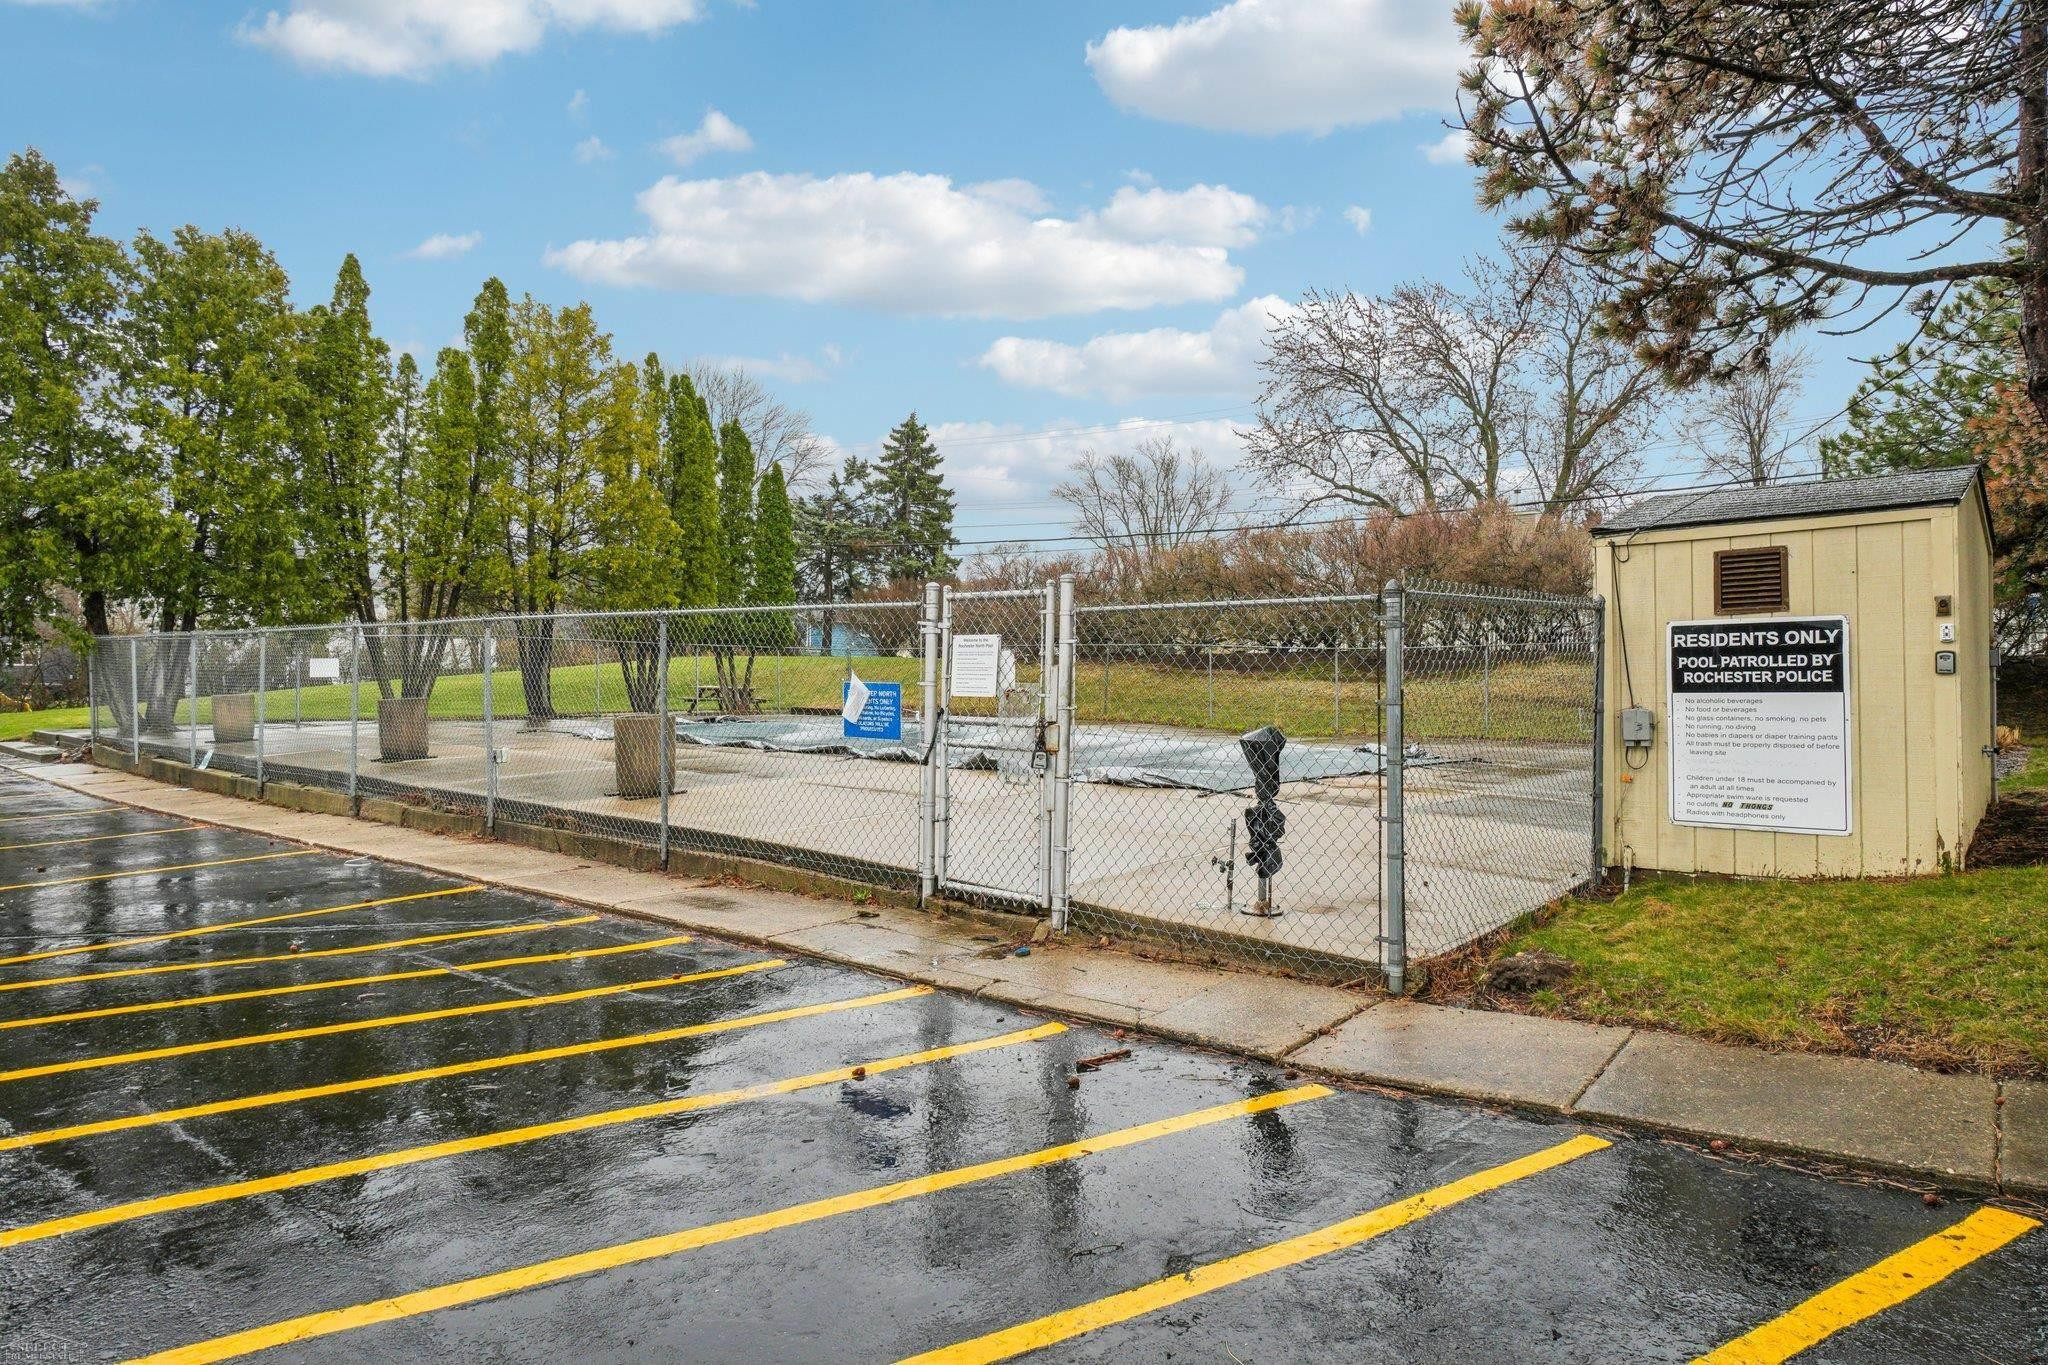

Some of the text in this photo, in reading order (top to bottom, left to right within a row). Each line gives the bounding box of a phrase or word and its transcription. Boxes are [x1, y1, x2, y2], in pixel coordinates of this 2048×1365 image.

[1674, 629, 1840, 648] RESIDENTS ONLY
[1678, 654, 1834, 668] POOL PATROLLED BY
[1683, 670, 1833, 683] ROCHESTER POLICE
[1740, 802, 1773, 810] THONGS
[1727, 811, 1769, 819] headphones
